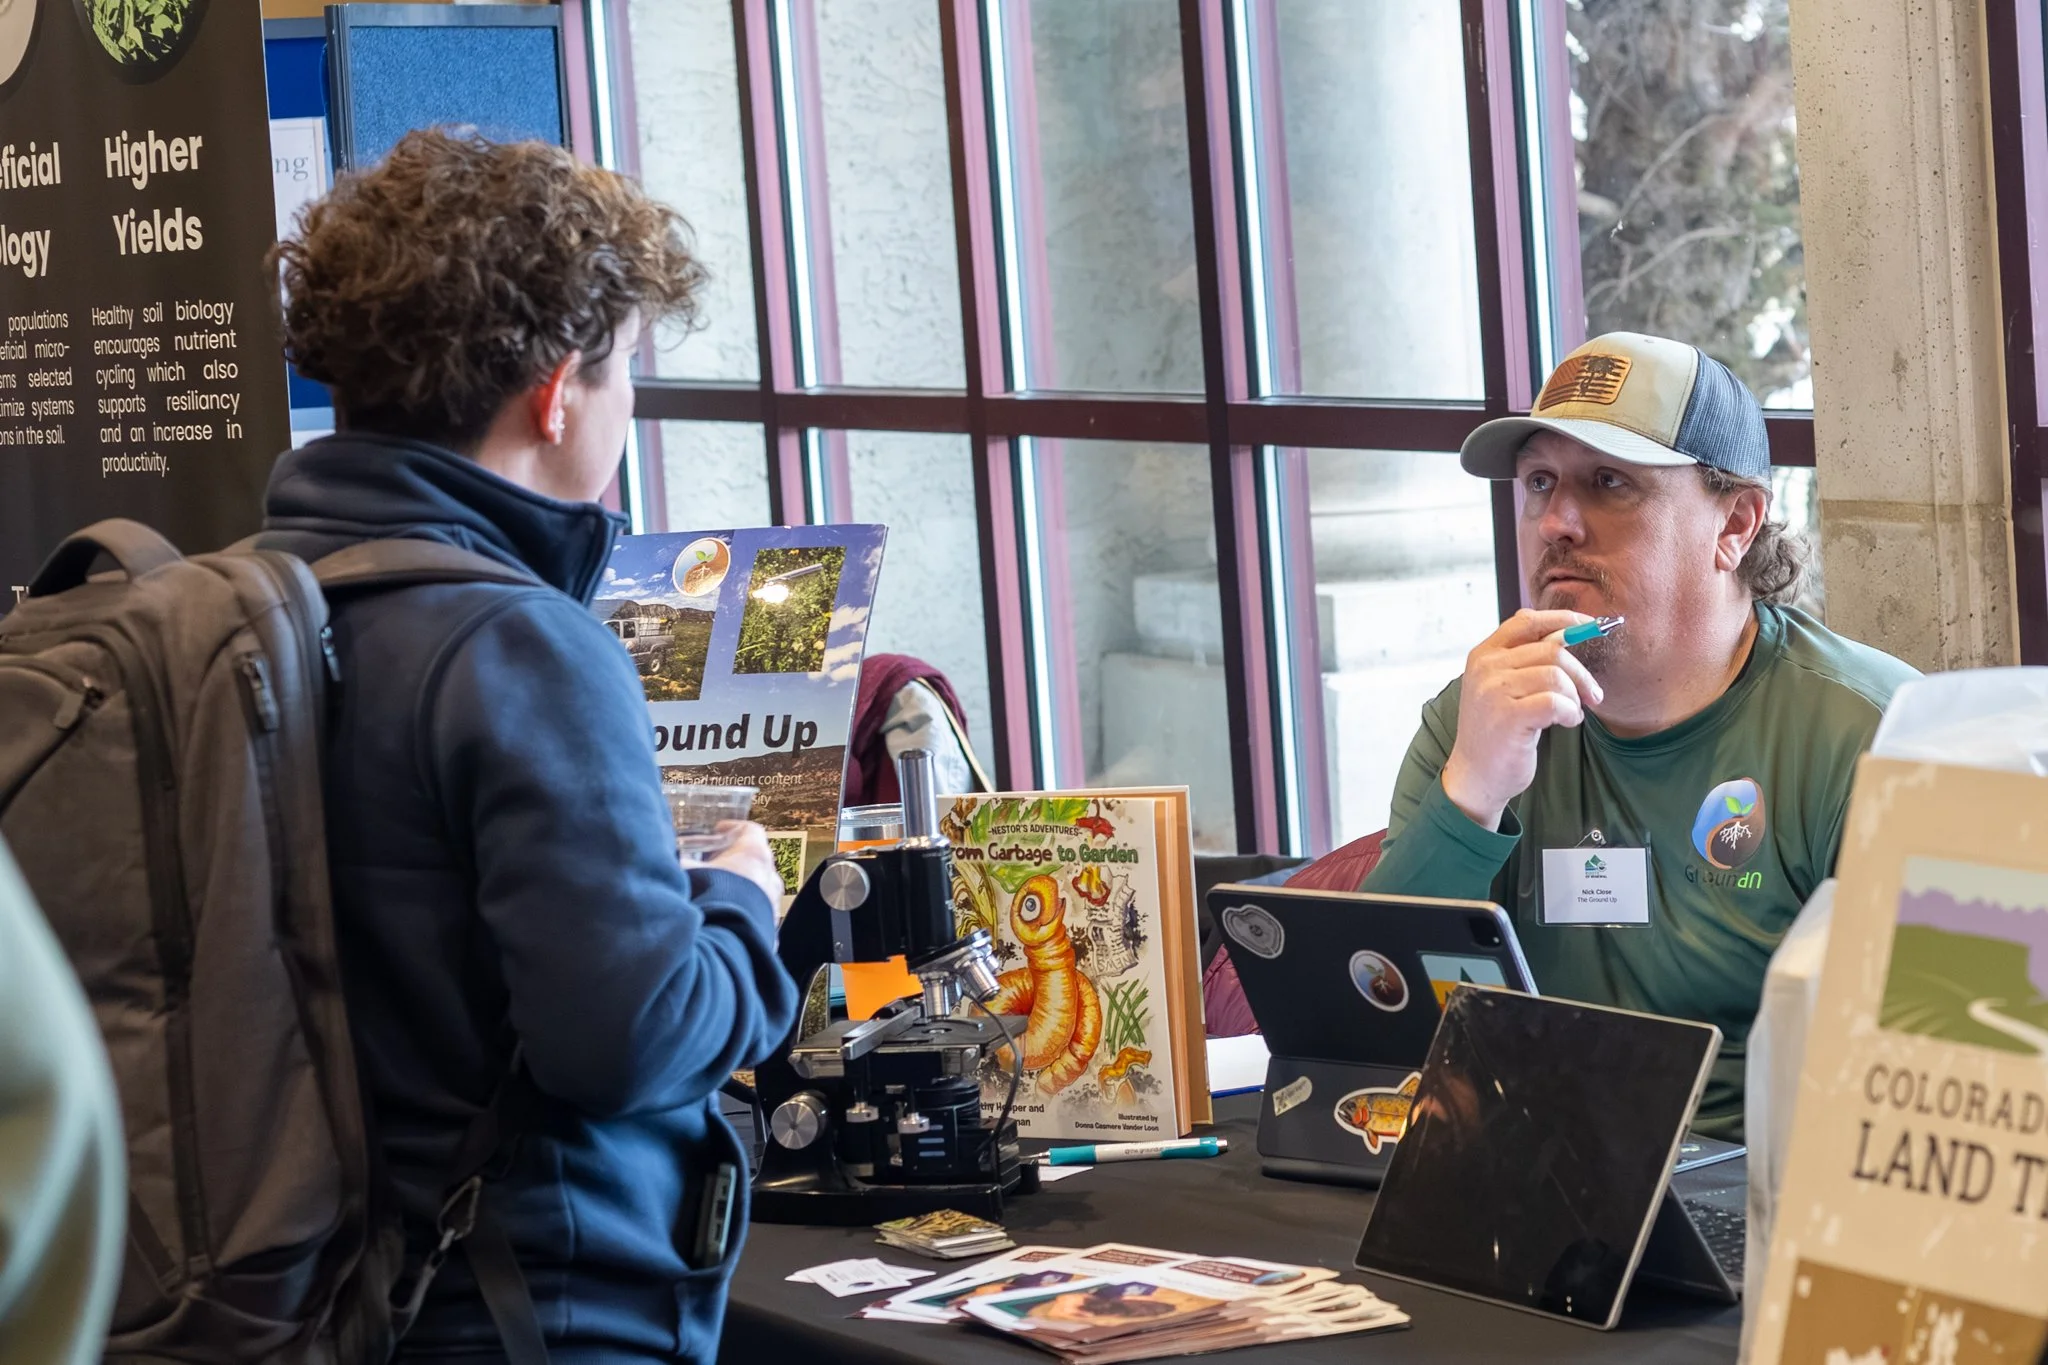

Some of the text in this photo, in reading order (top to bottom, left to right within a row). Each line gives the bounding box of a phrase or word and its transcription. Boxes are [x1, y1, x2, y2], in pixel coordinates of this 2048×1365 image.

[0, 141, 61, 190] ficial
[104, 130, 203, 190] Higher
[112, 207, 204, 255] Yields
[0, 224, 51, 278] logy
[8, 310, 69, 337] populations
[92, 299, 234, 330] Healthy soil biology
[35, 339, 70, 359] micro-
[93, 329, 237, 359] encourages nutrient
[28, 366, 73, 388] selected
[96, 359, 239, 391] cycling which also
[0, 397, 74, 422] imize systems
[98, 389, 240, 420] supports resiliancy
[16, 426, 25, 445] in
[26, 425, 44, 445] the
[46, 424, 66, 444] soil.
[100, 418, 243, 443] and an increase in
[102, 451, 170, 479] productivity.
[763, 714, 818, 759] Up
[687, 774, 709, 786] and
[710, 774, 755, 786] nutrient
[758, 773, 803, 786] content
[988, 842, 1053, 866] Garbage
[1057, 845, 1077, 863] to
[1079, 843, 1139, 863] Garden
[1610, 896, 1618, 904] Up
[1029, 1104, 1045, 1113] and
[1863, 1063, 2048, 1135] COLORAD
[1075, 1121, 1094, 1129] Donna
[1118, 1113, 1158, 1123] Illustrated by
[1852, 1118, 1996, 1205] LAND
